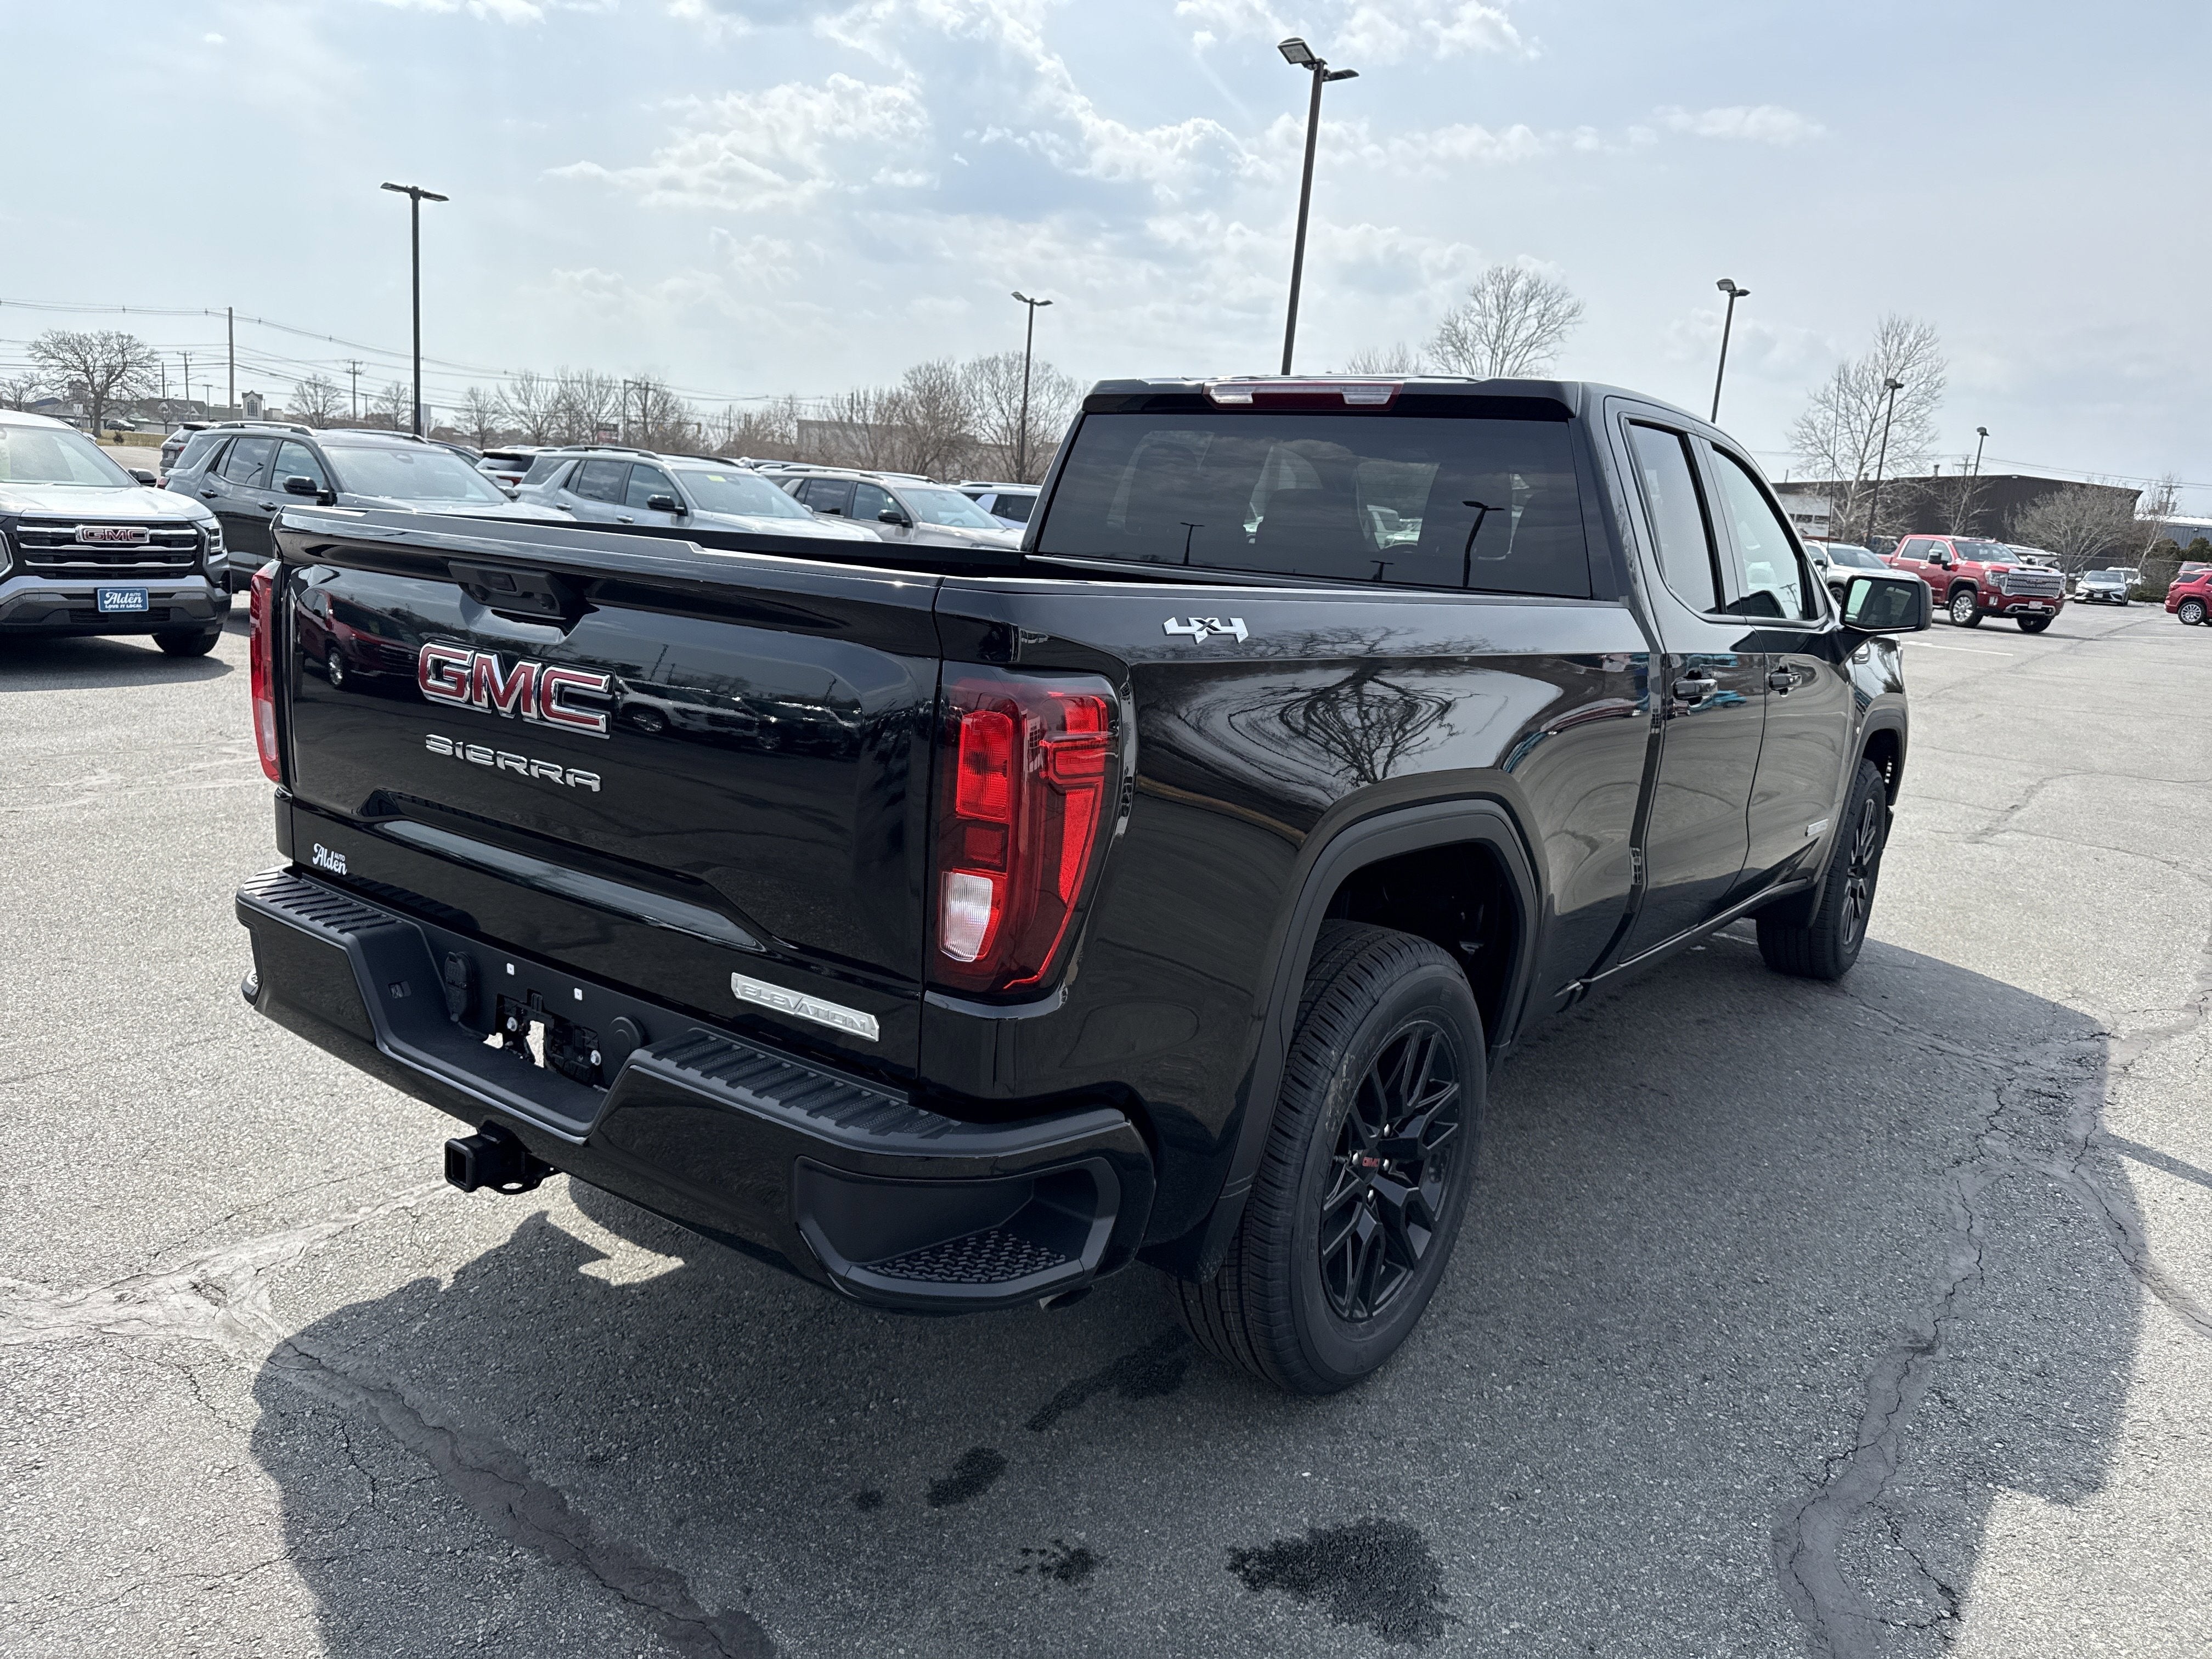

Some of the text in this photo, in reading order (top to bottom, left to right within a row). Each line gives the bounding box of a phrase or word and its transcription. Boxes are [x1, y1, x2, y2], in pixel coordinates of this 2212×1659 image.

[83, 528, 146, 541] GMC
[104, 591, 143, 605] Alden
[418, 641, 612, 739] GMC
[425, 733, 602, 792] SIERRA
[312, 843, 348, 876] Alden
[334, 851, 346, 862] AUTO
[741, 983, 866, 1032] ELEVATION
